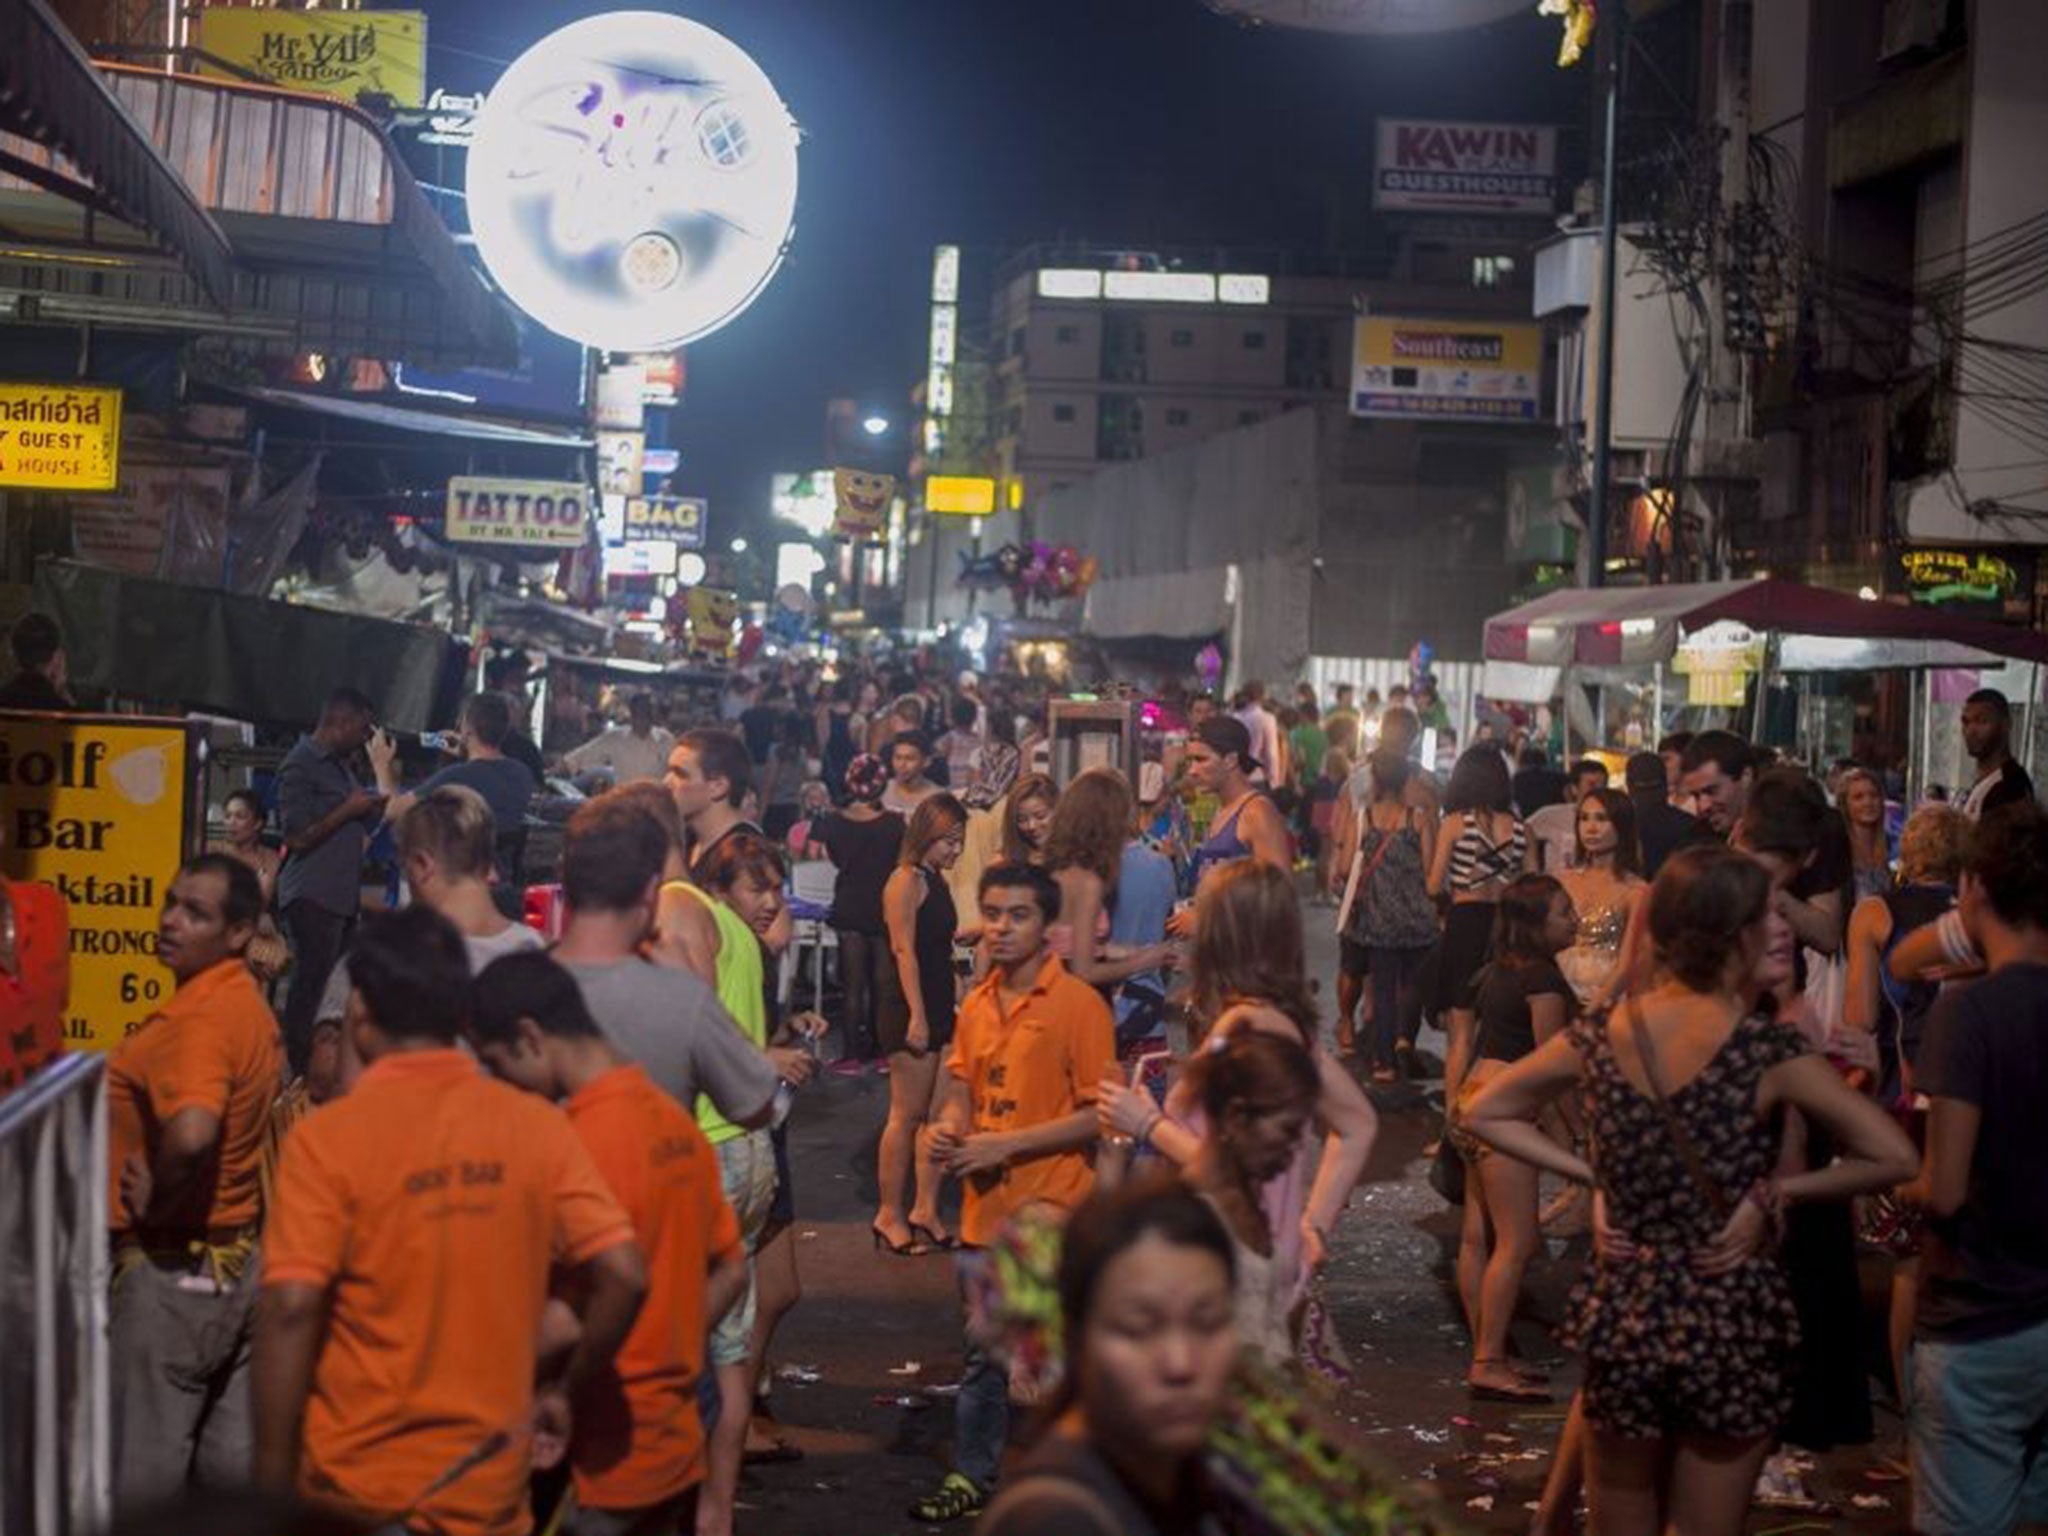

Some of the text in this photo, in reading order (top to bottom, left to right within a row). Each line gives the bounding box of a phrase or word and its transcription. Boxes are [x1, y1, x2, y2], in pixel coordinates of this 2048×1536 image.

[1396, 125, 1538, 169] KAWIN
[1384, 172, 1548, 194] GUESTHOUSE
[1393, 334, 1501, 358] Southeast
[19, 430, 84, 450] GUEST
[455, 489, 580, 525] TATTOO
[627, 500, 699, 527] BAG
[1901, 551, 1968, 568] CENTER
[15, 809, 115, 852] Bar
[39, 873, 153, 907] ktail
[120, 973, 160, 1003] 60
